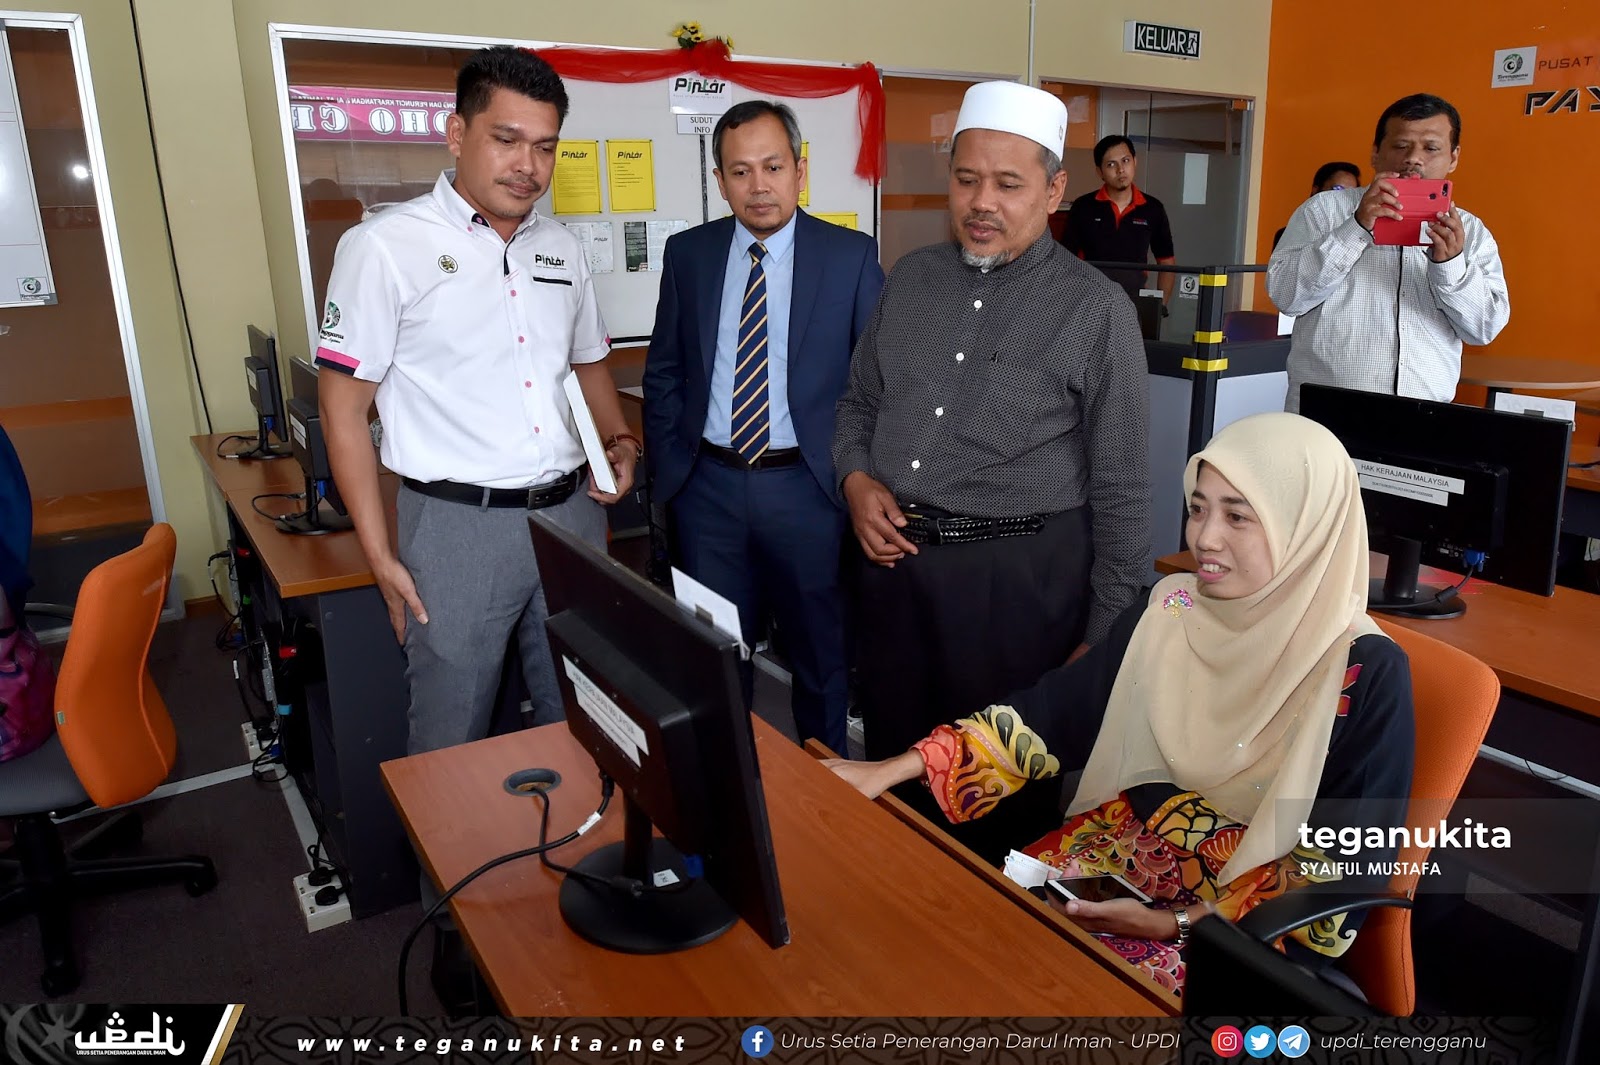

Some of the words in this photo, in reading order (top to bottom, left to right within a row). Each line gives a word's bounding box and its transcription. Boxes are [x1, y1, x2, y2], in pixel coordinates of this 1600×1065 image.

[1137, 25, 1186, 53] KELUAR
[1538, 56, 1593, 70] PUSAT
[1361, 463, 1375, 473] HAK
[1375, 467, 1412, 480] KERAJAAN
[1413, 474, 1449, 487] MALAYSIA
